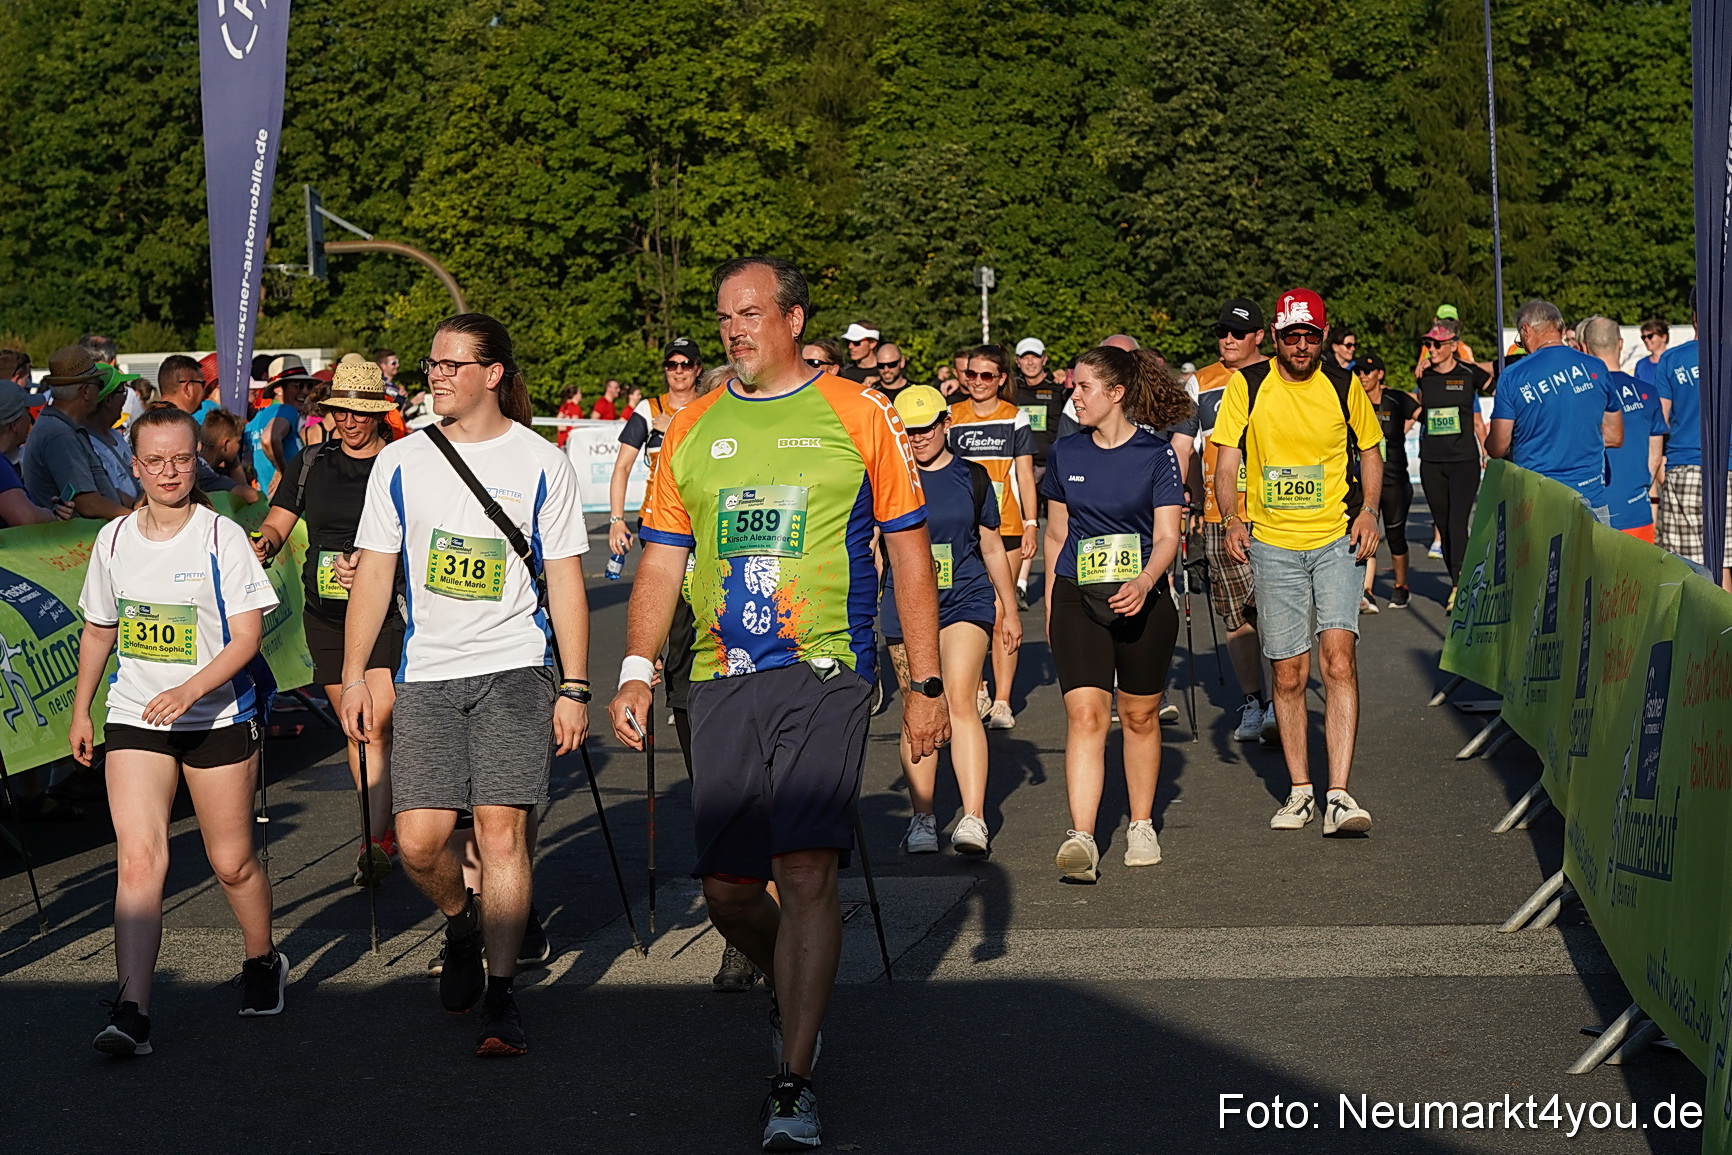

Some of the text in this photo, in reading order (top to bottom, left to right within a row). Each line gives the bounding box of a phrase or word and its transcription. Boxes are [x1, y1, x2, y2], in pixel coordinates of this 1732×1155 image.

[234, 128, 268, 399] w.fischer-automobile.de
[1519, 381, 1532, 394] bei
[1572, 382, 1594, 395] läufts
[1433, 416, 1454, 427] 1508
[777, 438, 821, 448] BOCK
[965, 435, 1006, 447] Fischer
[1273, 480, 1315, 495] 1260
[736, 509, 780, 533] 589
[790, 514, 801, 547] 2022
[721, 520, 729, 544] RUN
[726, 533, 791, 544] Kirsch Alexander
[430, 553, 439, 583] WALK
[443, 555, 486, 579] 318
[1087, 550, 1131, 569] 1248
[492, 564, 502, 592] 2022
[1087, 568, 1116, 576] Schneidr
[439, 575, 487, 589] Müller Mario
[136, 621, 175, 644] 310
[129, 640, 185, 653] Hofmann Sophia
[1645, 690, 1665, 719] Fischer
[1620, 783, 1681, 876] firmenlauf
